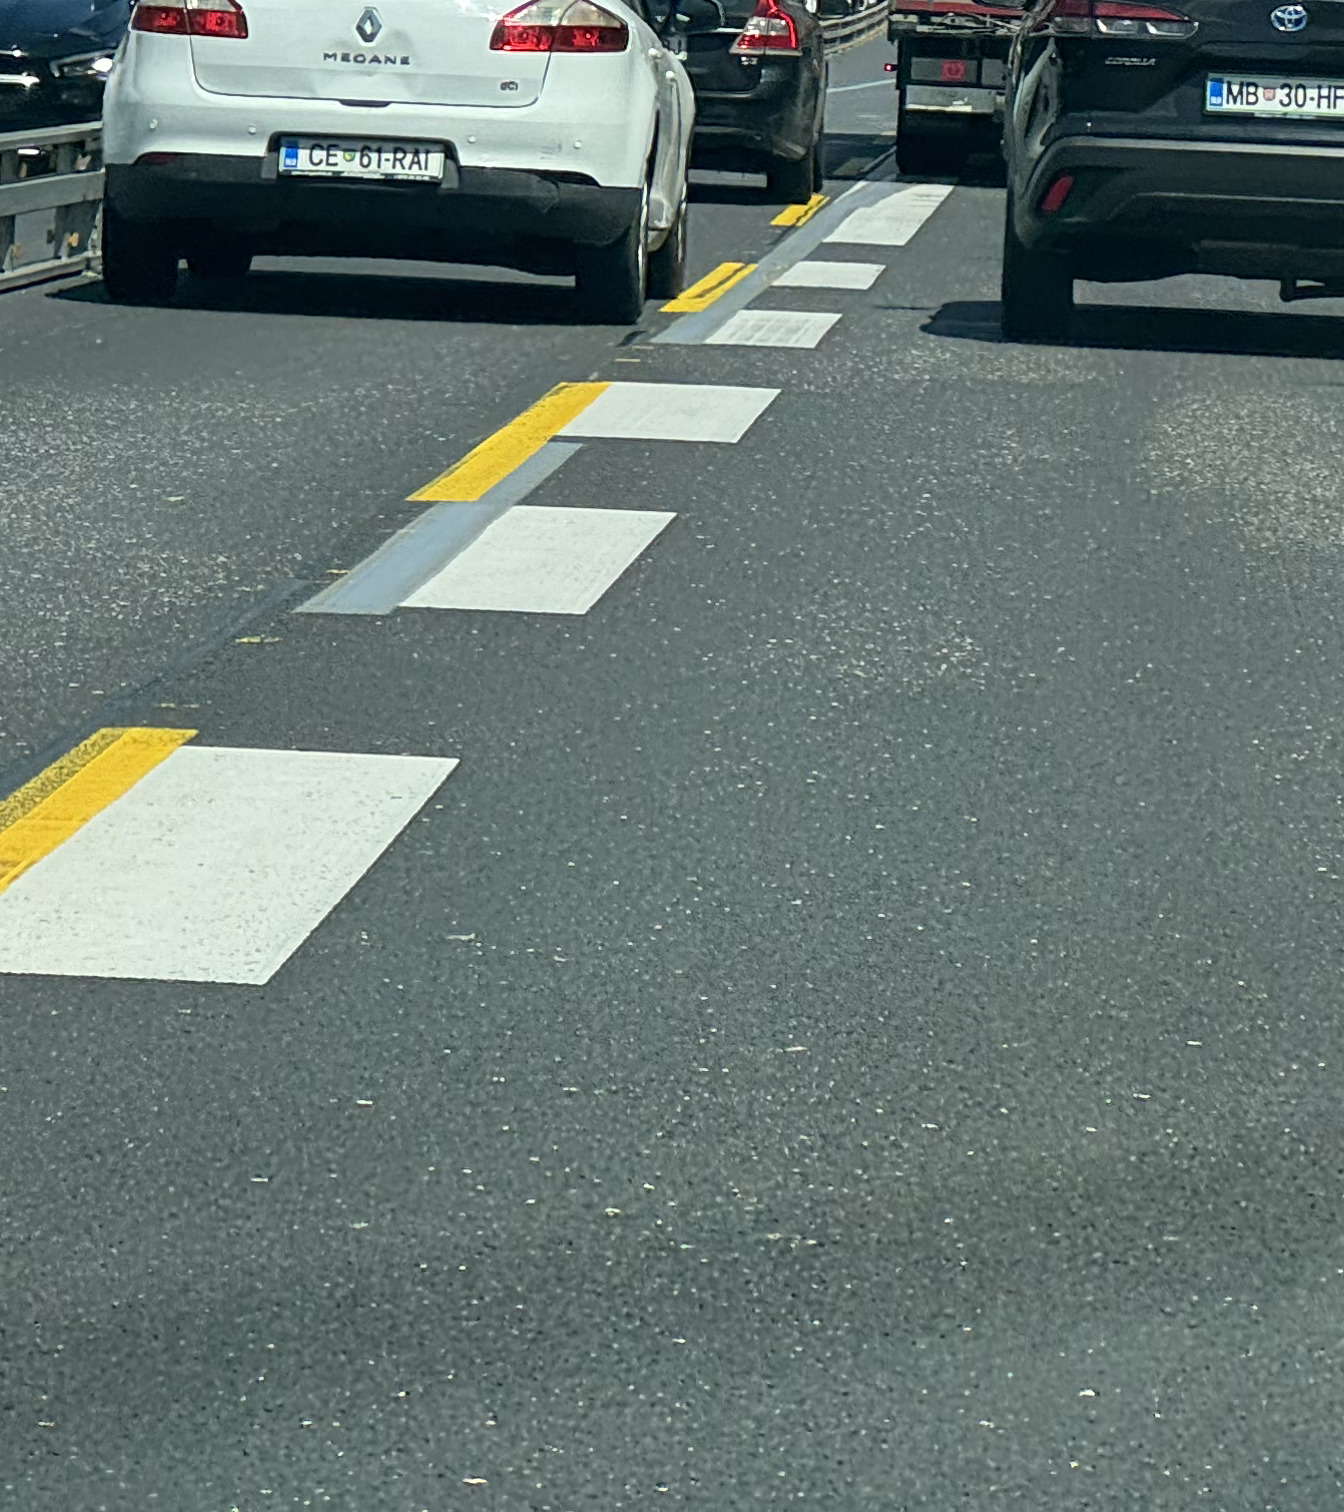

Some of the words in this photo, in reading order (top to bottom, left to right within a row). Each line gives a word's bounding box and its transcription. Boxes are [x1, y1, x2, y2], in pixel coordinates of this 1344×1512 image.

[1225, 80, 1259, 106] MB
[308, 143, 339, 167] CE
[359, 145, 430, 172] 61-RAI
